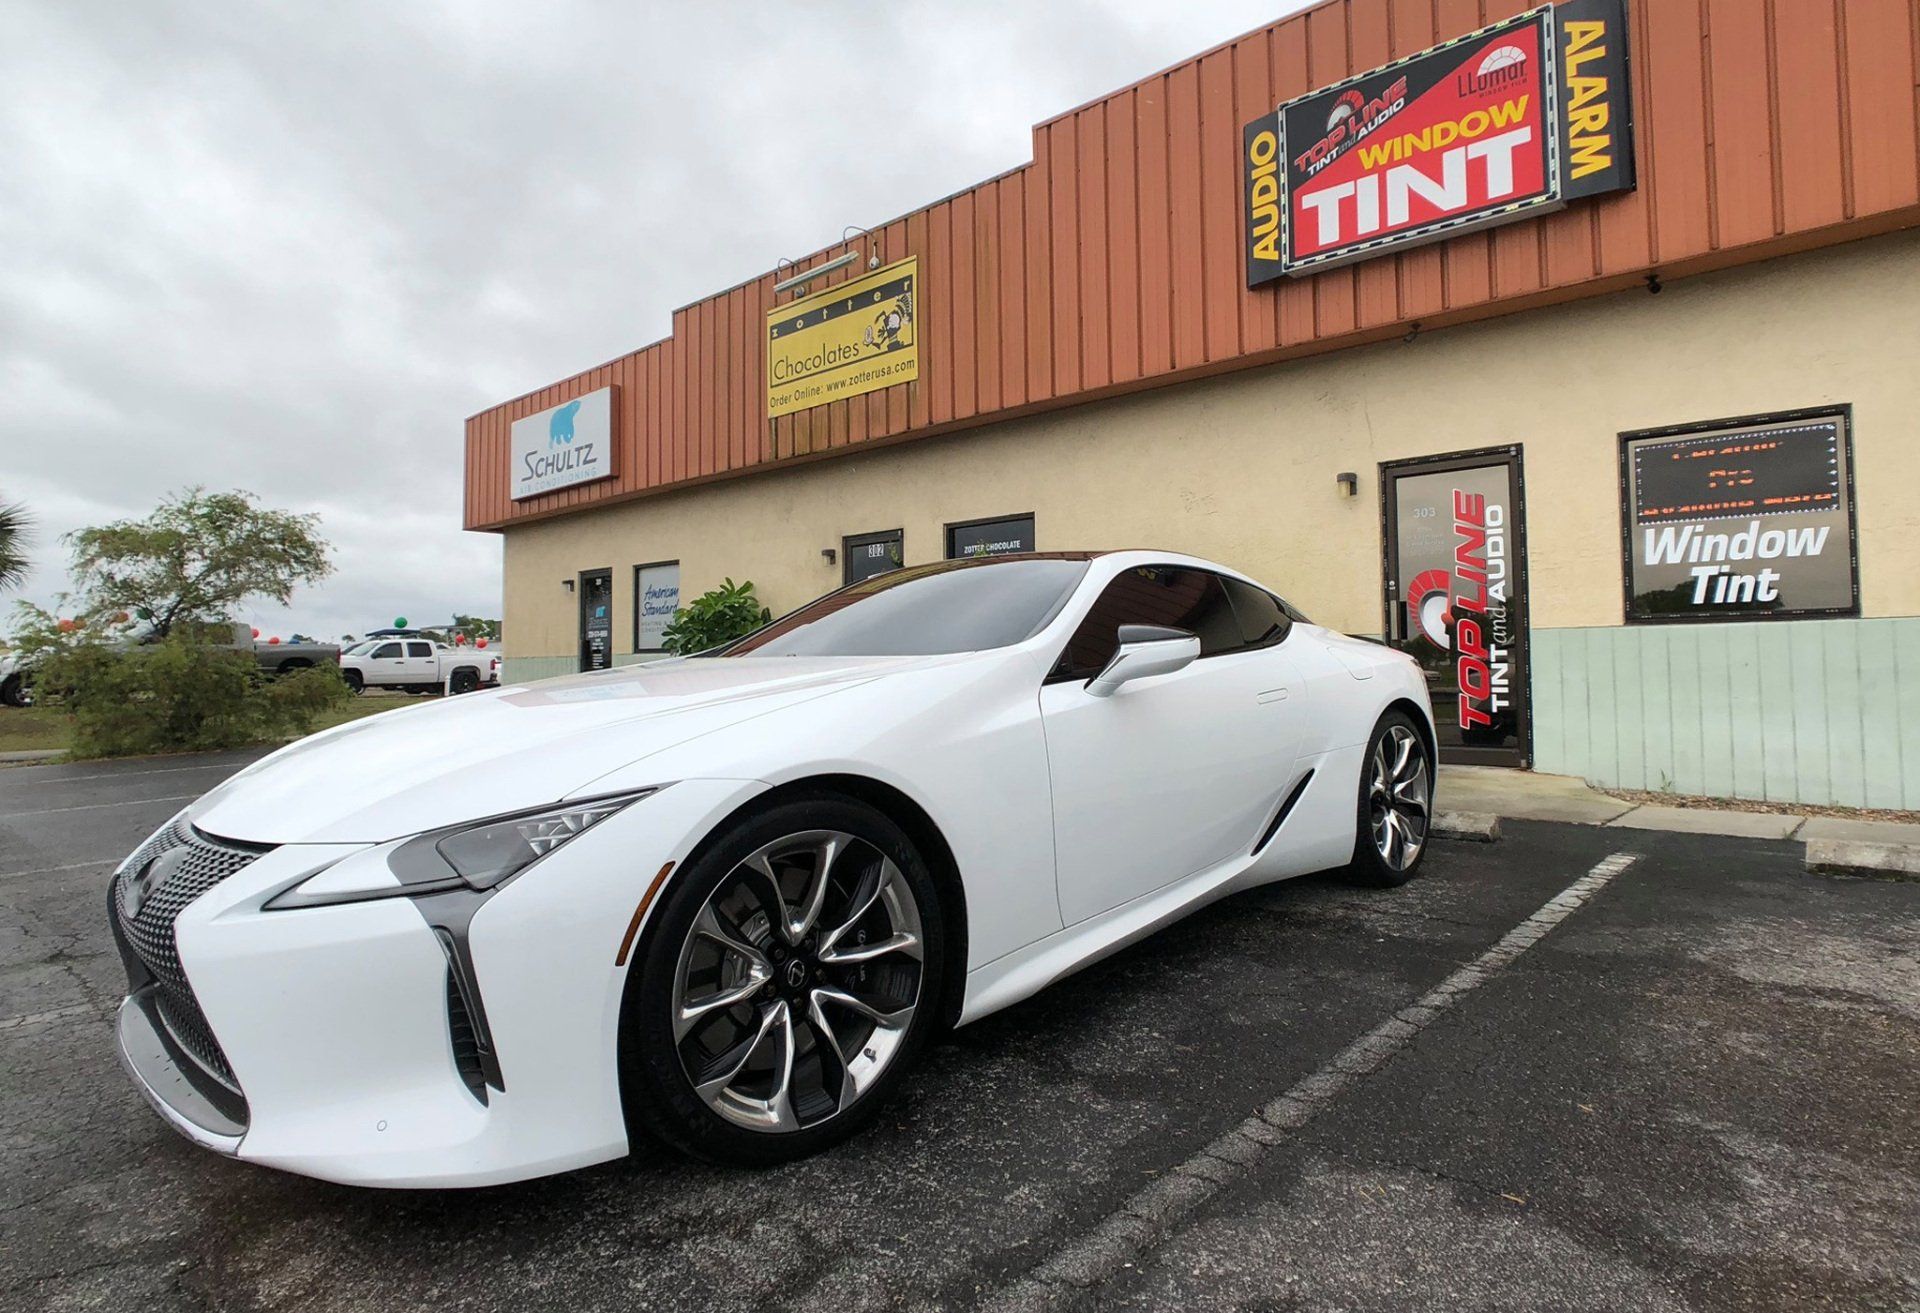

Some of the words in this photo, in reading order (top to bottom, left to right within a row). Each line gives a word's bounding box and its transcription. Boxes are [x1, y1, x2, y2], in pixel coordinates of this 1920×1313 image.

[1294, 125, 1346, 173] TOP
[1348, 75, 1409, 134] LINE
[1357, 94, 1530, 170] WINDOW
[1564, 20, 1614, 180] ALARM
[1306, 146, 1340, 176] TINT
[1357, 97, 1405, 141] AUDIO
[1249, 130, 1279, 262] AUDIO
[1301, 126, 1532, 246] TINT
[769, 392, 792, 409] Order
[794, 383, 824, 402] Online:
[827, 358, 914, 391] www.zotterusa.com
[773, 342, 860, 380] Chocolates
[985, 540, 1021, 552] CHOCOLATE
[1413, 507, 1436, 519] 303
[1644, 521, 1830, 565] Window
[868, 544, 885, 558] 302
[1452, 488, 1488, 616] LINE
[1485, 504, 1506, 602] AUDIO
[1690, 564, 1780, 605] Tint
[1486, 601, 1506, 645] and
[1457, 618, 1492, 731] TOP
[1490, 644, 1509, 713] TINT
